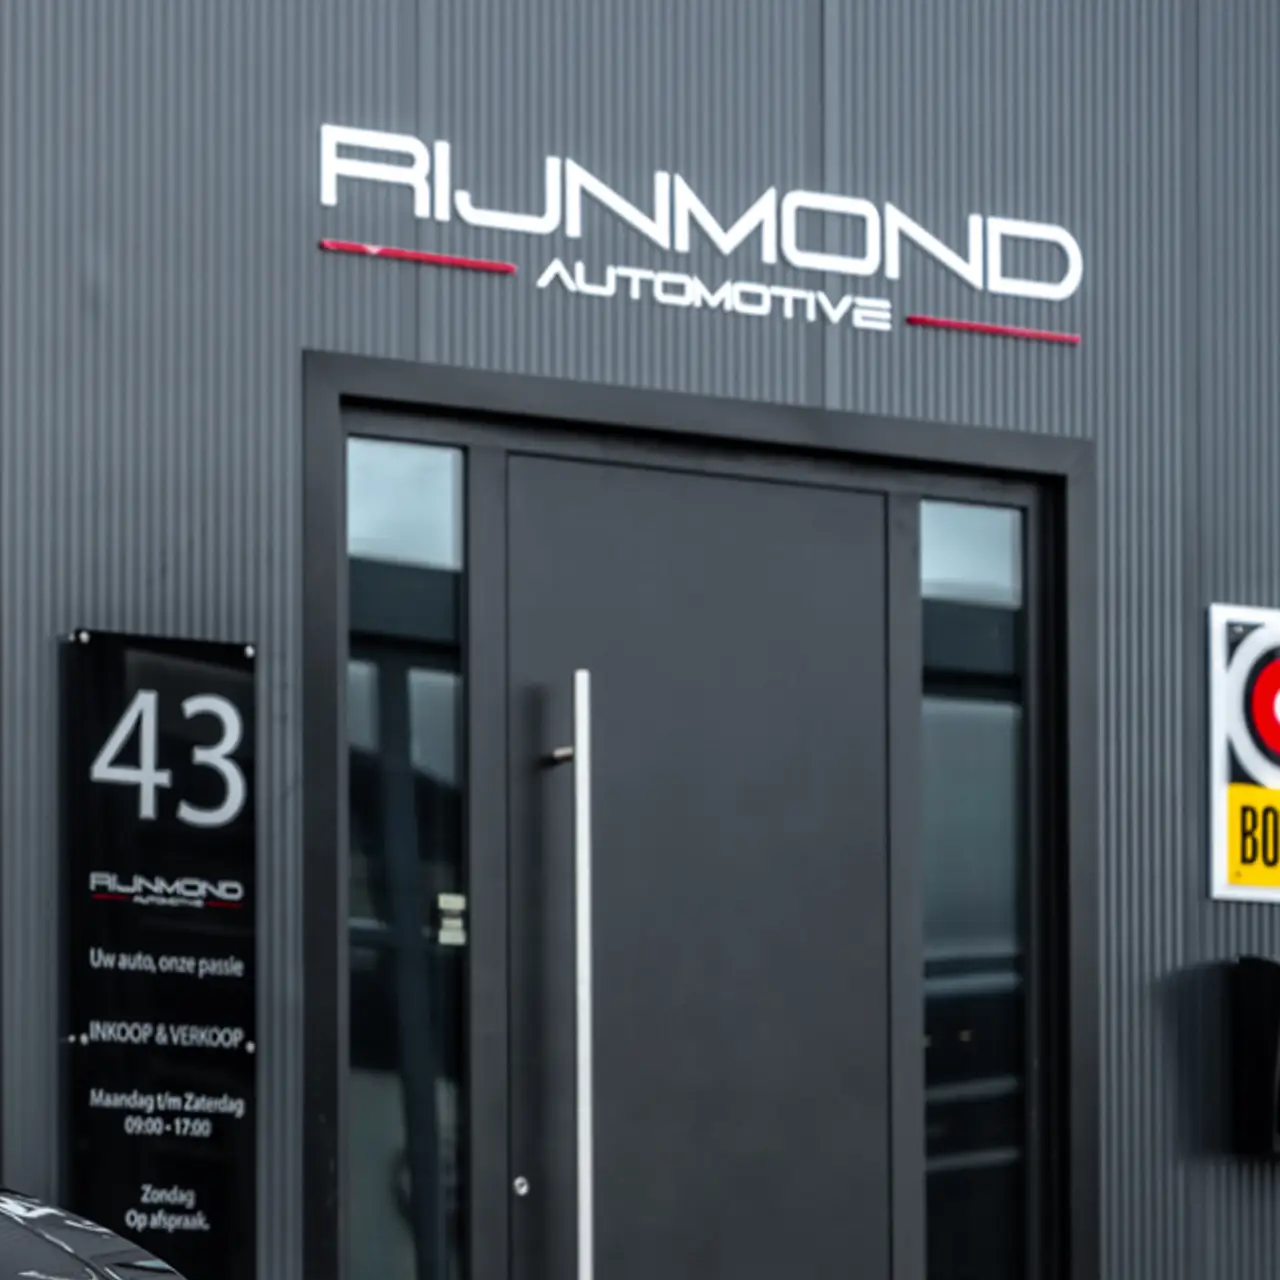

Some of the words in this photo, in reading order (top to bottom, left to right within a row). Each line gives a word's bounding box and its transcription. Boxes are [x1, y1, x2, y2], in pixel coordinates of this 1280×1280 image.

[320, 123, 1084, 301] RIJNMOND
[536, 257, 894, 332] AUTOMOTIVE
[90, 688, 248, 827] 43
[90, 870, 244, 901] RIJNMOND
[90, 947, 115, 969] Uw
[118, 951, 157, 974] auto,
[158, 955, 196, 974] onze
[198, 955, 245, 979] passie
[90, 1020, 154, 1044] INKOOP
[155, 1023, 168, 1045] &
[169, 1024, 245, 1048] VERKOOP
[90, 1088, 155, 1114] Maandag
[156, 1090, 182, 1111] t/m
[183, 1091, 246, 1118] Zaterdag
[124, 1115, 164, 1135] 09:00
[173, 1116, 212, 1137] 17:00
[141, 1183, 196, 1209] Zondag
[125, 1208, 148, 1232] Op
[150, 1208, 210, 1232] afspraak.
